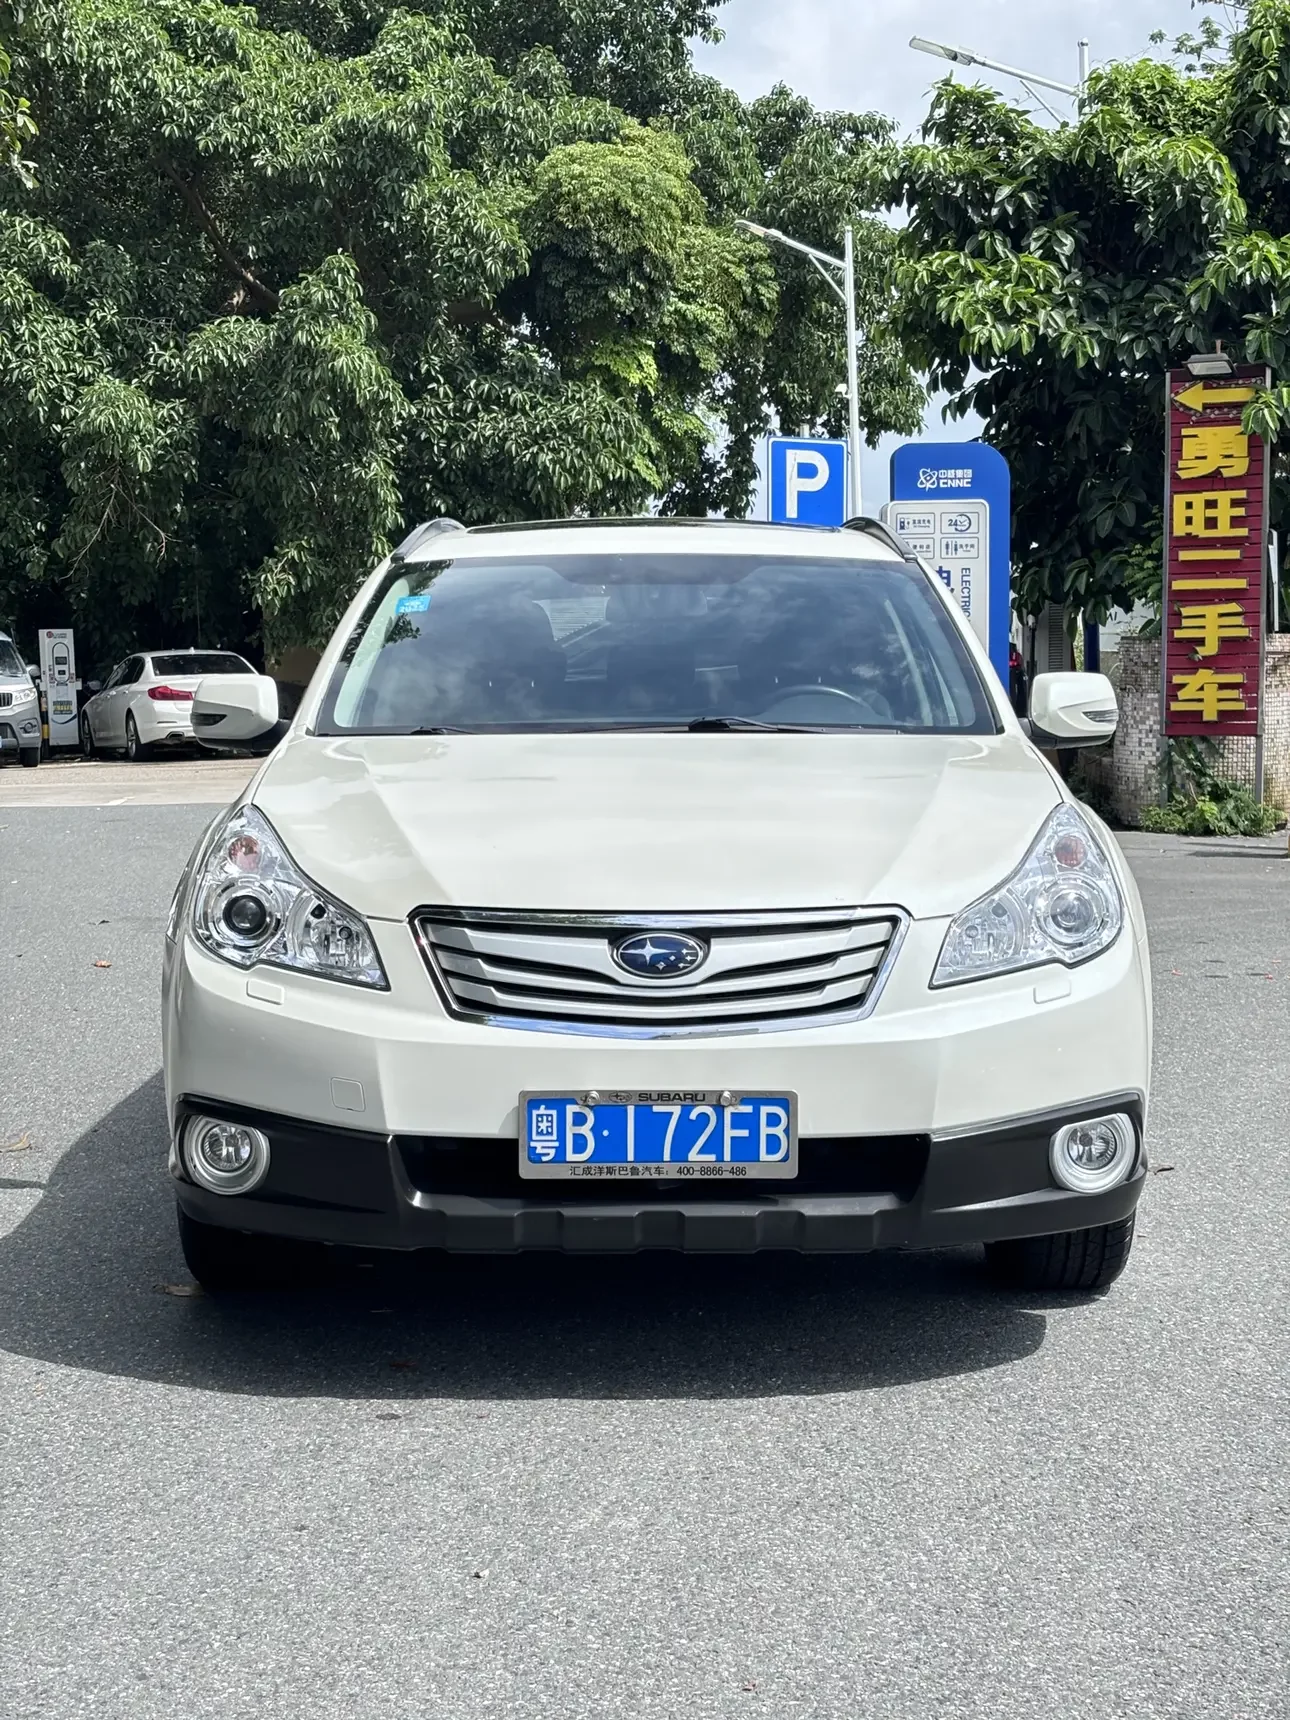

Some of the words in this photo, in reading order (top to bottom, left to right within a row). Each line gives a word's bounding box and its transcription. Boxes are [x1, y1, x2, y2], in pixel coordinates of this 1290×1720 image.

[785, 449, 829, 518] P
[939, 479, 972, 488] CNNC
[947, 518, 957, 526] 24
[1170, 426, 1250, 721] 勇旺二手车
[960, 567, 971, 622] ELECTRIC
[638, 1092, 706, 1102] SUBARU
[676, 1165, 747, 1177] 400-8866-486
